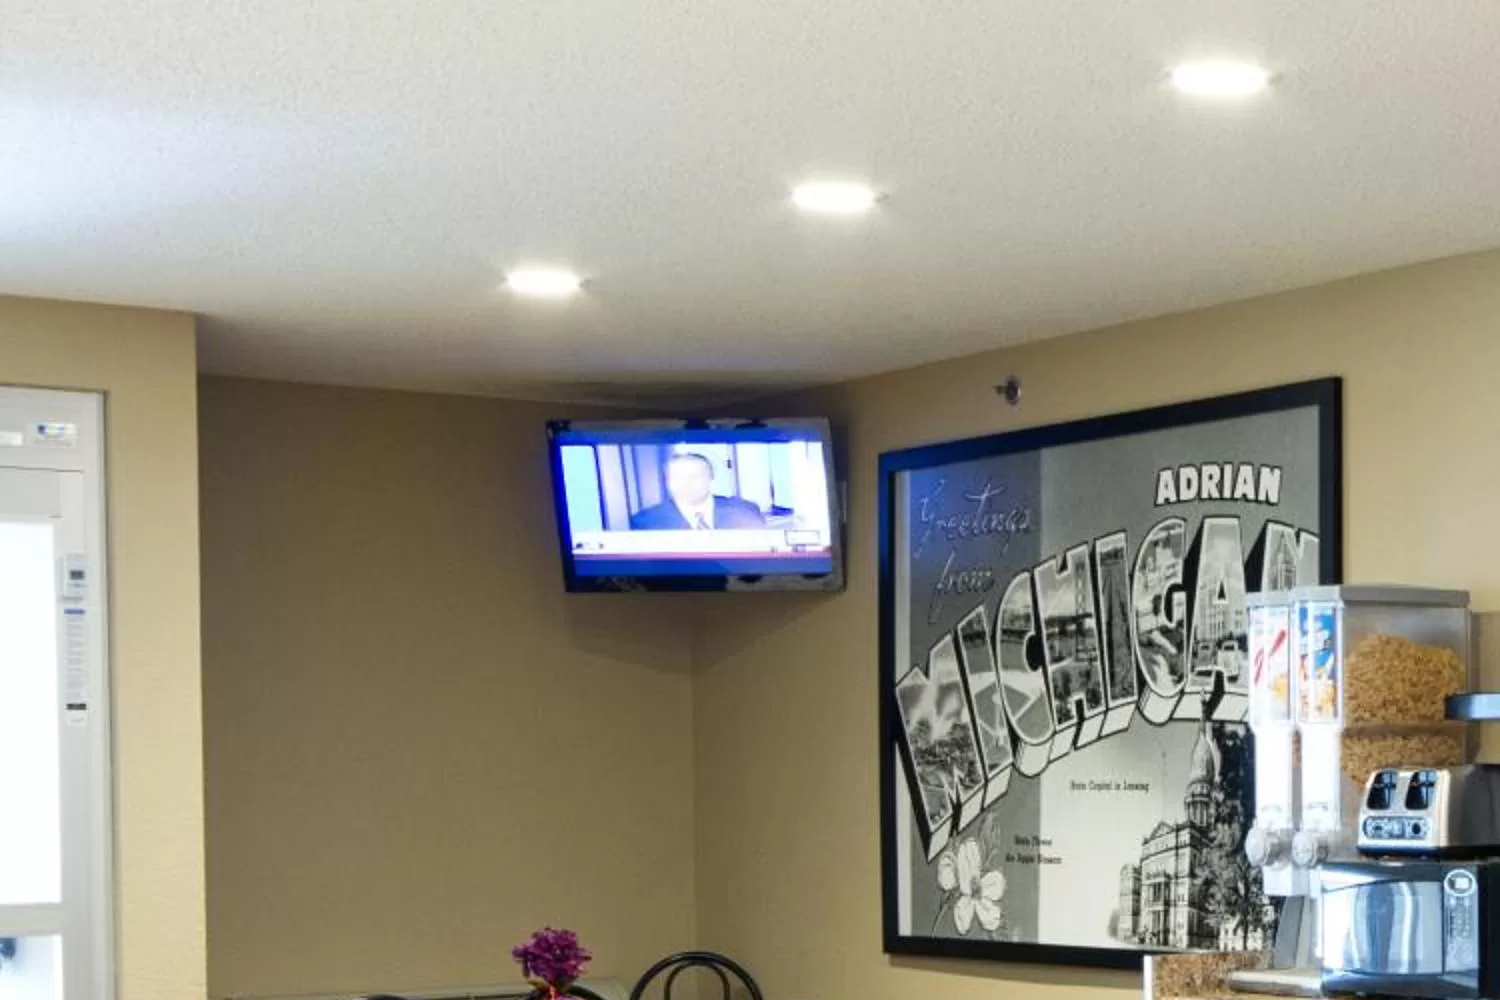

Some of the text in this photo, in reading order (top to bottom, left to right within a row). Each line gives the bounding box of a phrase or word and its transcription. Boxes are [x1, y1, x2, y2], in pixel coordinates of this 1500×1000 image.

[914, 478, 1033, 560] Greetings
[1155, 461, 1281, 506] ADRIAN
[928, 550, 995, 625] from
